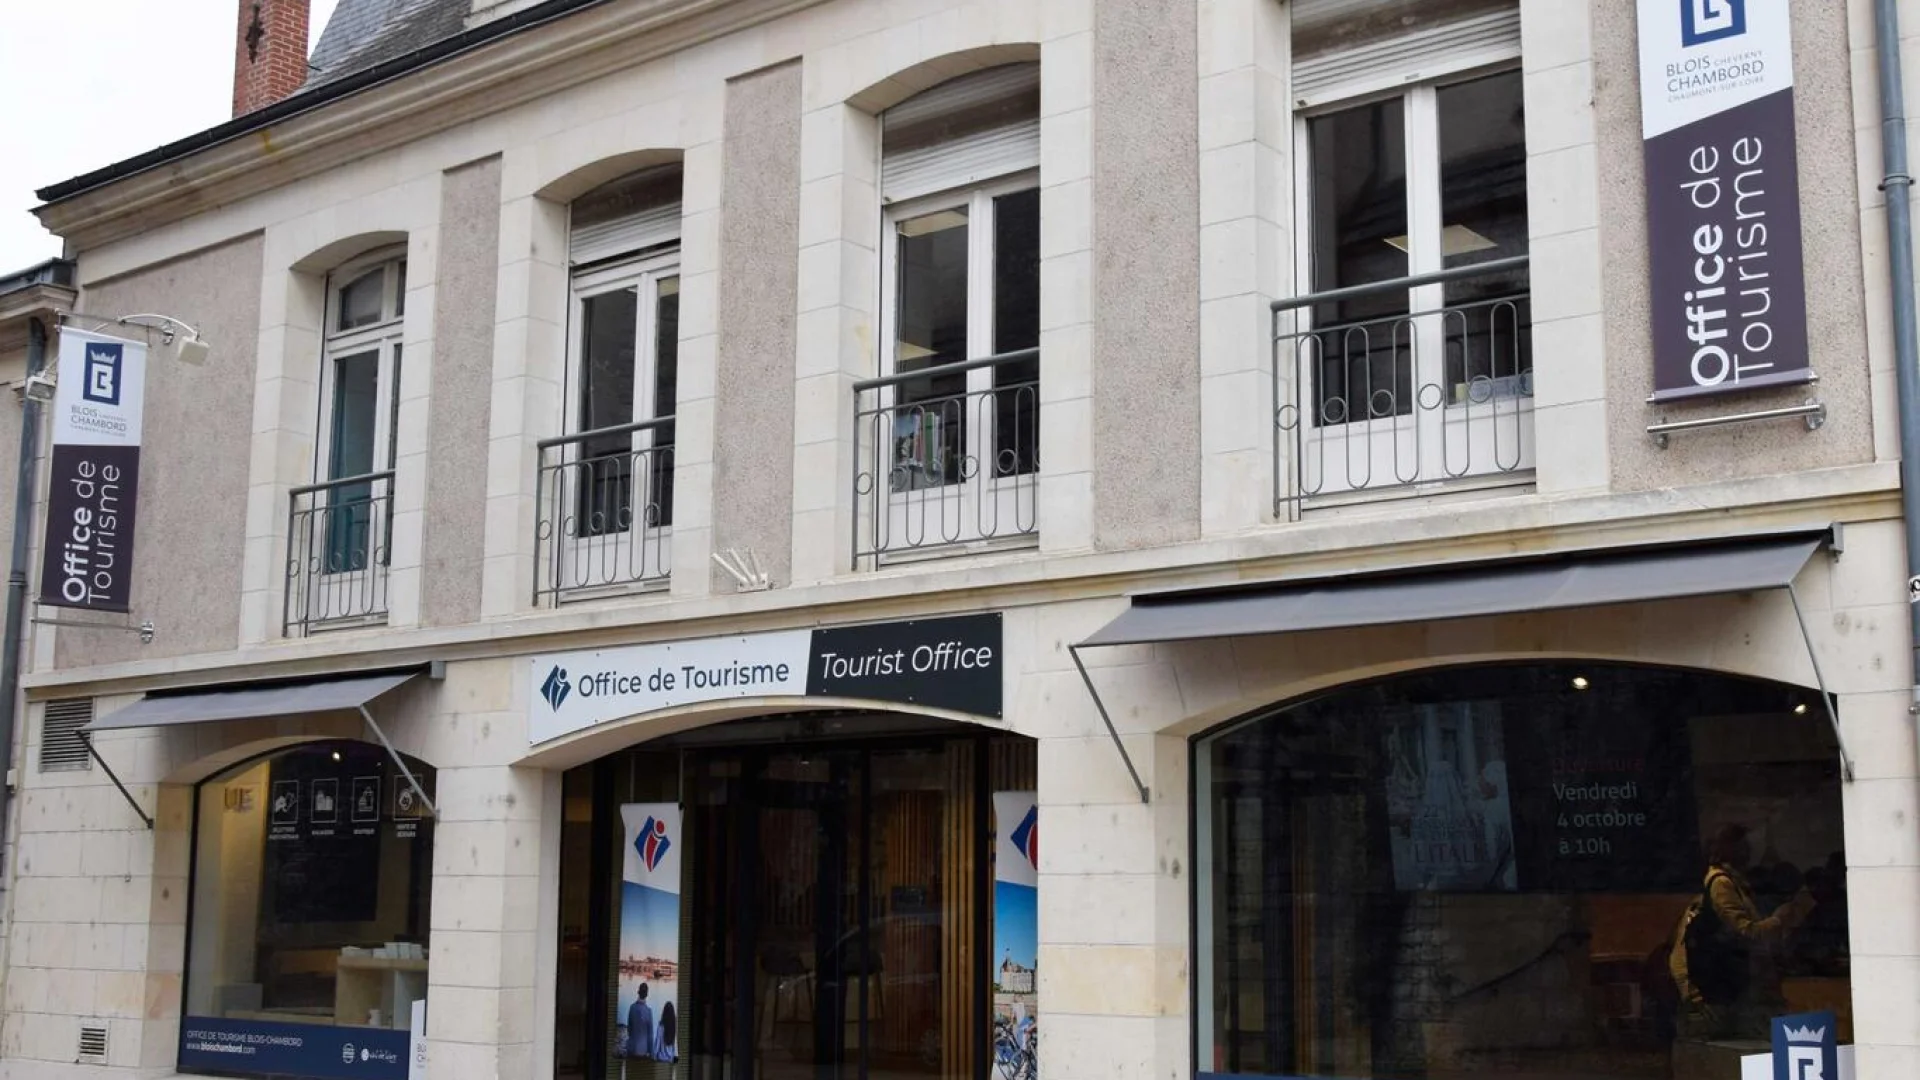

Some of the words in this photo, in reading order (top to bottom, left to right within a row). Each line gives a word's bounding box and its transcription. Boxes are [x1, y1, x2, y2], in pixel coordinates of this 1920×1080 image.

[1666, 55, 1710, 77] BLOIS
[1667, 59, 1764, 92] CHAMBORD
[1679, 145, 1721, 209] de
[1727, 136, 1775, 384] Tourisme
[1684, 223, 1730, 387] Office
[71, 404, 98, 417] BLOIS
[71, 414, 127, 432] CHAMBORD
[70, 460, 96, 499] de
[87, 464, 120, 605] Tourisme
[62, 506, 92, 603] Office
[821, 647, 905, 679] Tourist
[911, 640, 993, 673] Office
[578, 670, 642, 698] Office
[648, 667, 676, 692] de
[681, 660, 790, 690] Tourisme
[1552, 780, 1638, 801] Vendredi
[1557, 812, 1569, 828] 4
[1573, 810, 1646, 828] octobre
[1575, 837, 1611, 855] 10h
[186, 1029, 208, 1041] OFFICE
[208, 1031, 217, 1041] DE
